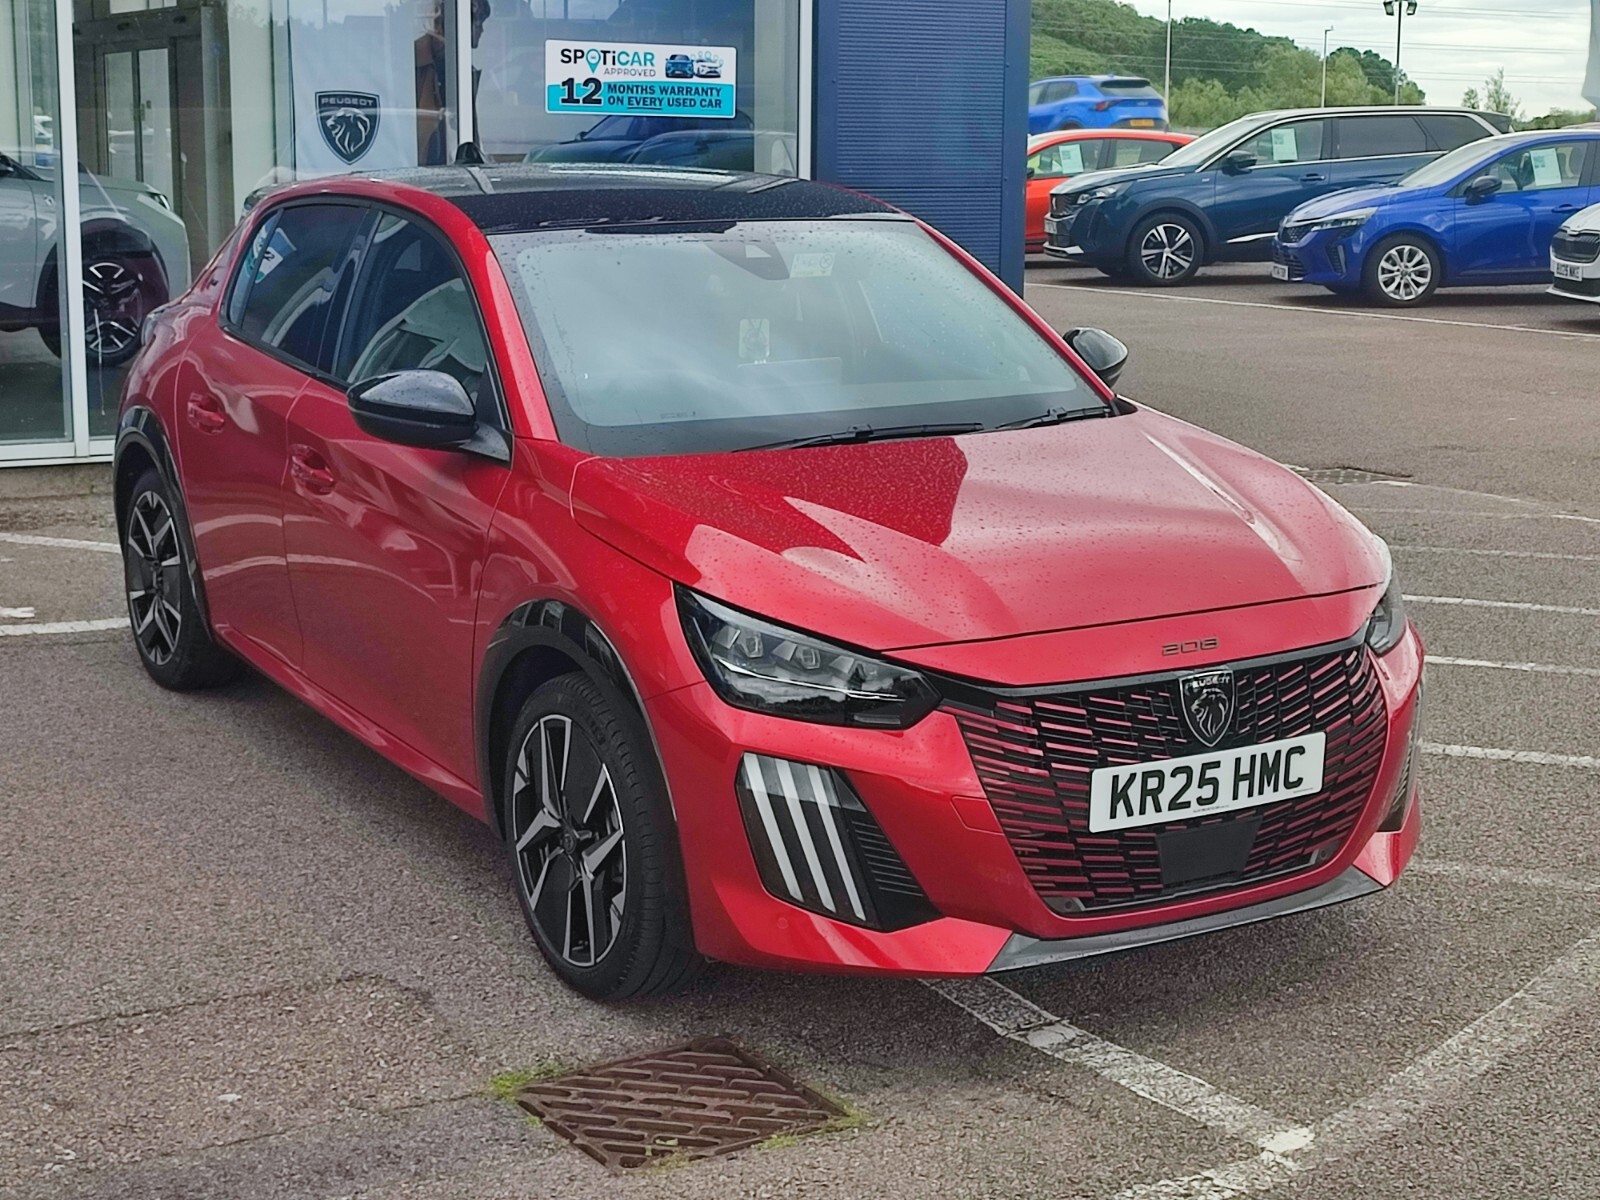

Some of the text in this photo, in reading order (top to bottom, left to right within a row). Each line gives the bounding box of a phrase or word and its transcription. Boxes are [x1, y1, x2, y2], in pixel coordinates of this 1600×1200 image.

[603, 67, 656, 77] APPROVED
[560, 77, 602, 104] 12
[607, 83, 722, 97] MONTHS WARRANTY
[321, 97, 374, 106] PEUGEOT
[607, 95, 722, 109] ON EVERY USED CAR
[1162, 638, 1218, 656] 208
[1109, 745, 1306, 820] KR25 HMC
